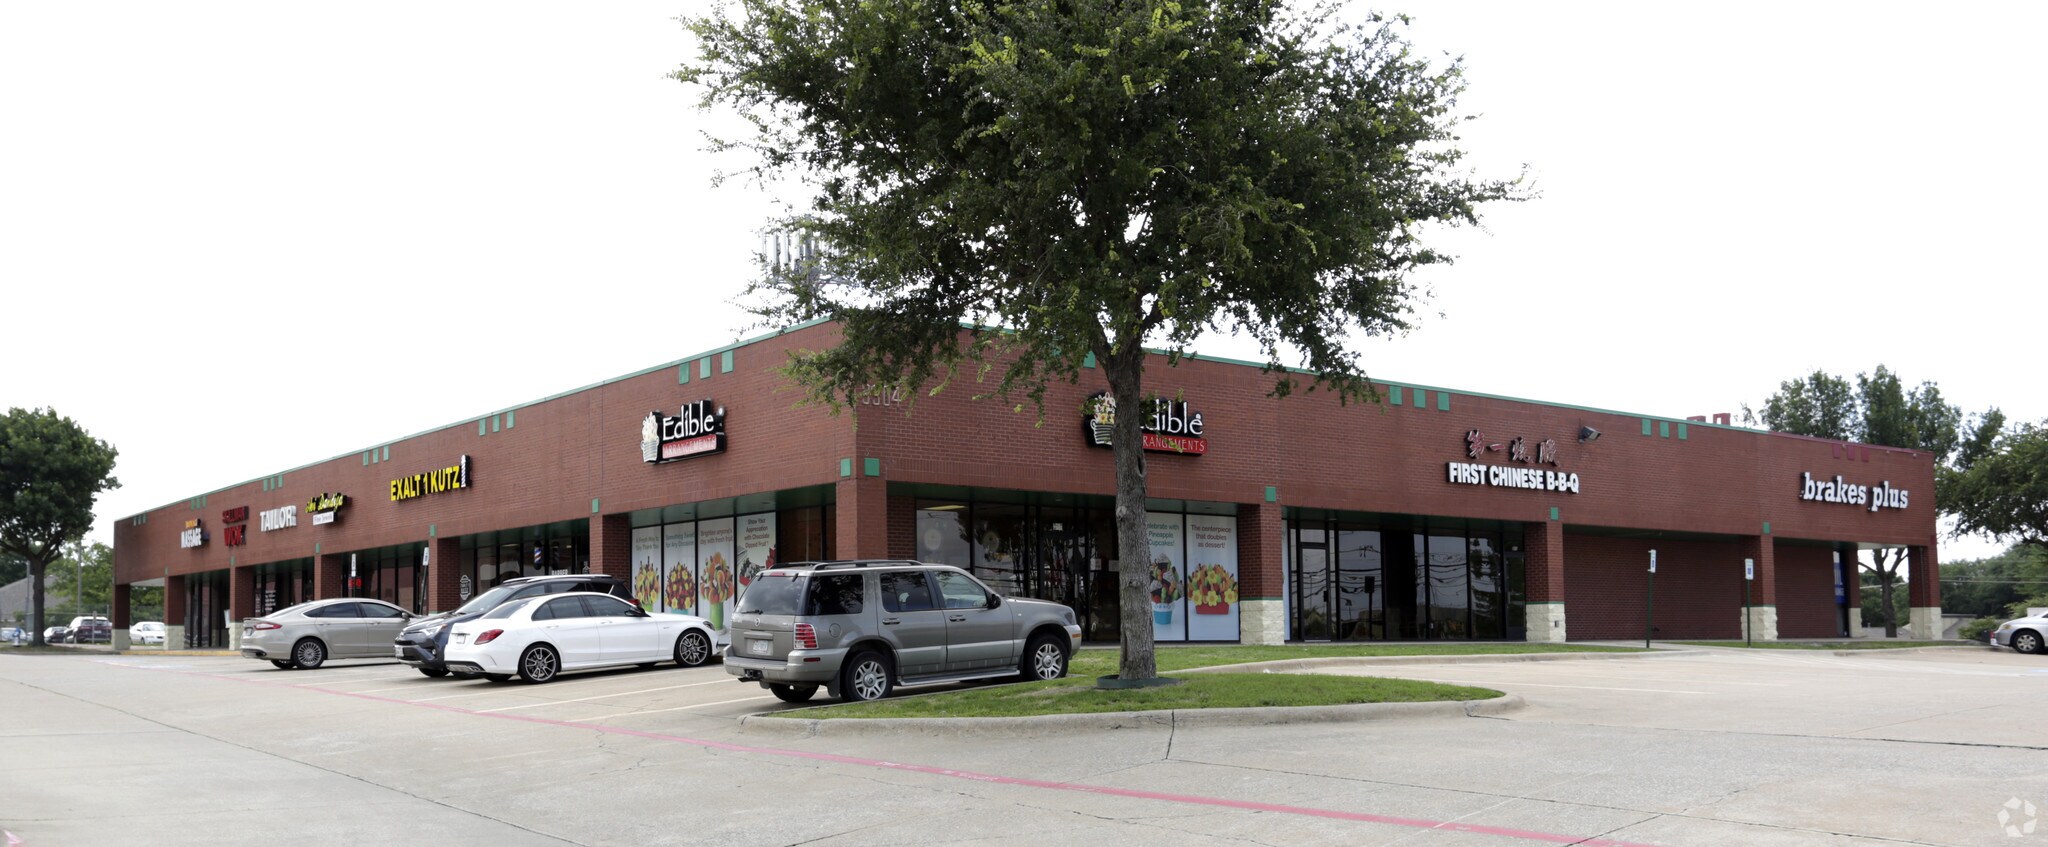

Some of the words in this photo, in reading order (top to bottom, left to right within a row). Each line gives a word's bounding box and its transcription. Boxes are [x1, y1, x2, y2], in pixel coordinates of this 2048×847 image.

[662, 400, 714, 441] Edible
[1140, 399, 1203, 434] dible
[663, 436, 717, 456] ARRANGEMENTS
[391, 474, 420, 501] EXALT
[423, 472, 428, 495] 1
[430, 465, 460, 493] KUTZ
[1450, 462, 1487, 485] FIRST
[1489, 465, 1544, 490] CHINESE
[1546, 471, 1579, 494] B-B-Q
[1803, 472, 1867, 505] brakes
[1871, 481, 1909, 512] plus
[260, 505, 296, 532] TAILOR
[1201, 526, 1232, 534] centerpiece
[1149, 531, 1174, 539] Pineapple
